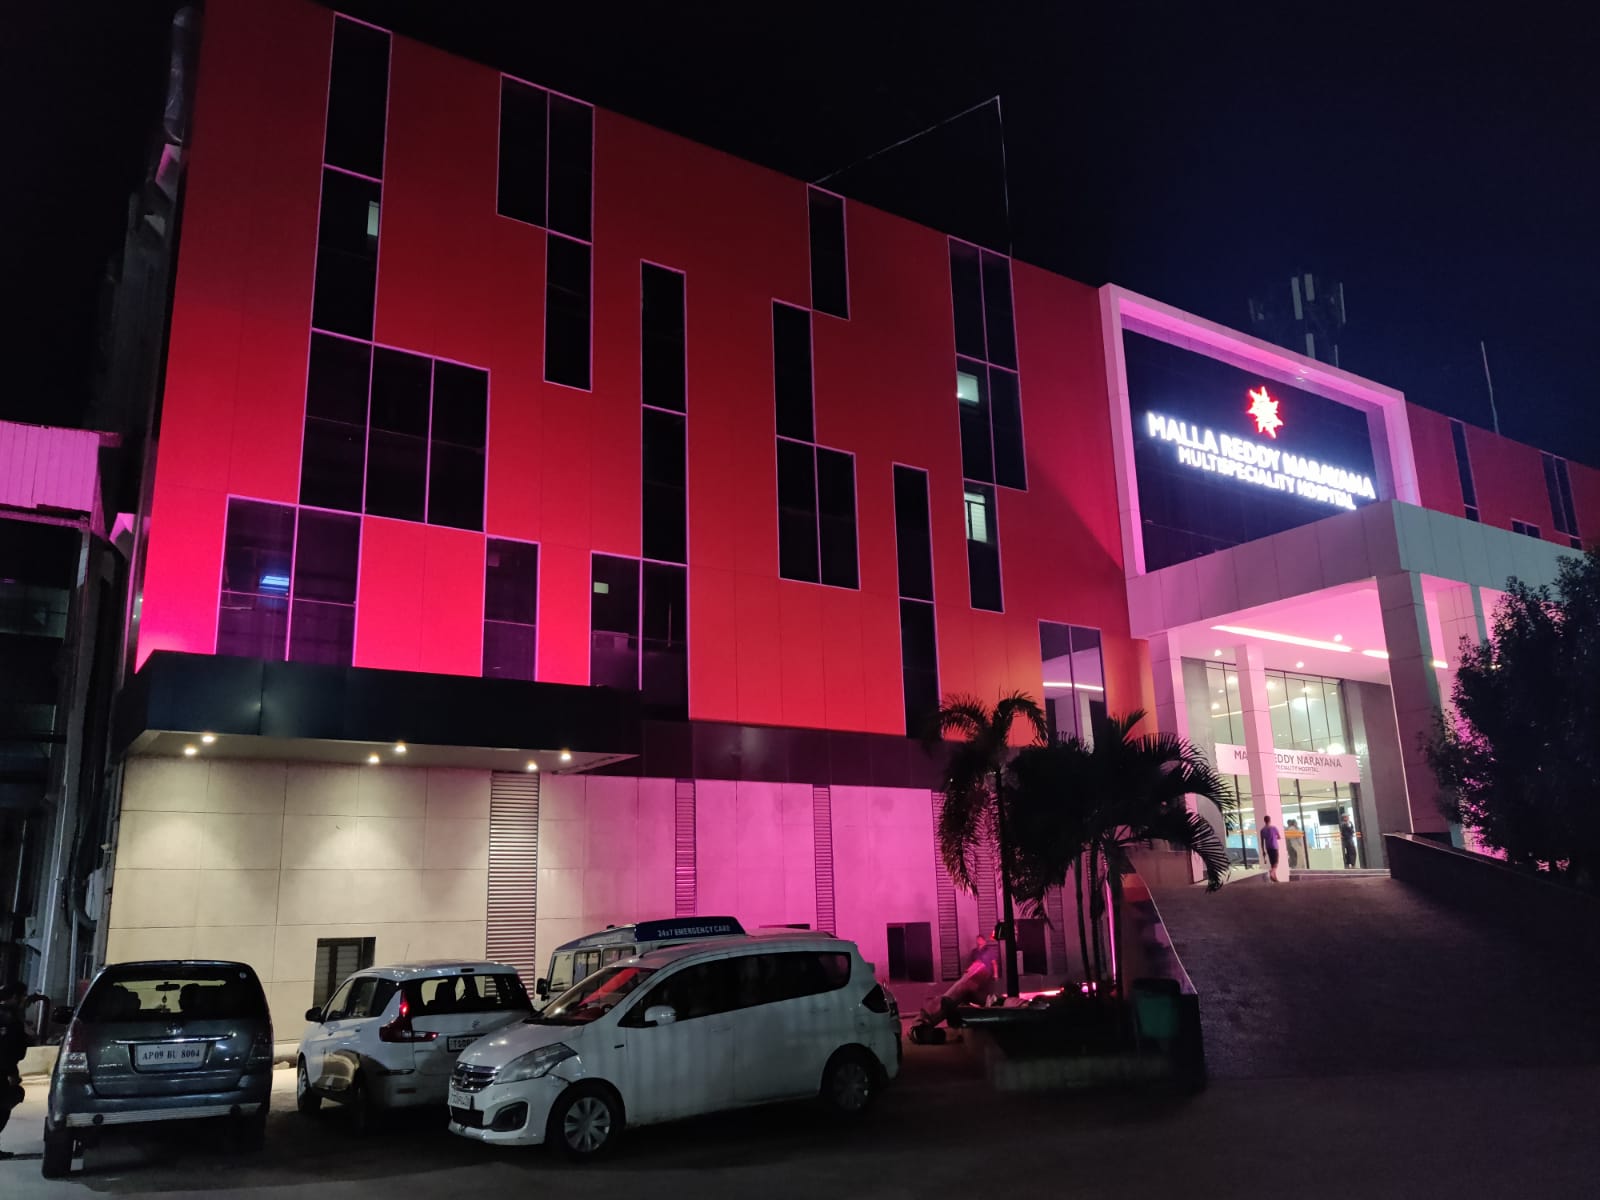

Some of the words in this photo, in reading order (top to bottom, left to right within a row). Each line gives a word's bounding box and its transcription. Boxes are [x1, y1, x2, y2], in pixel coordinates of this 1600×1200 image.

[1147, 411, 1218, 455] MALLA
[1220, 432, 1281, 471] REDDY
[1296, 755, 1343, 768] NARAYANA
[674, 926, 713, 936] EMERGENCY
[713, 924, 731, 933] CARE
